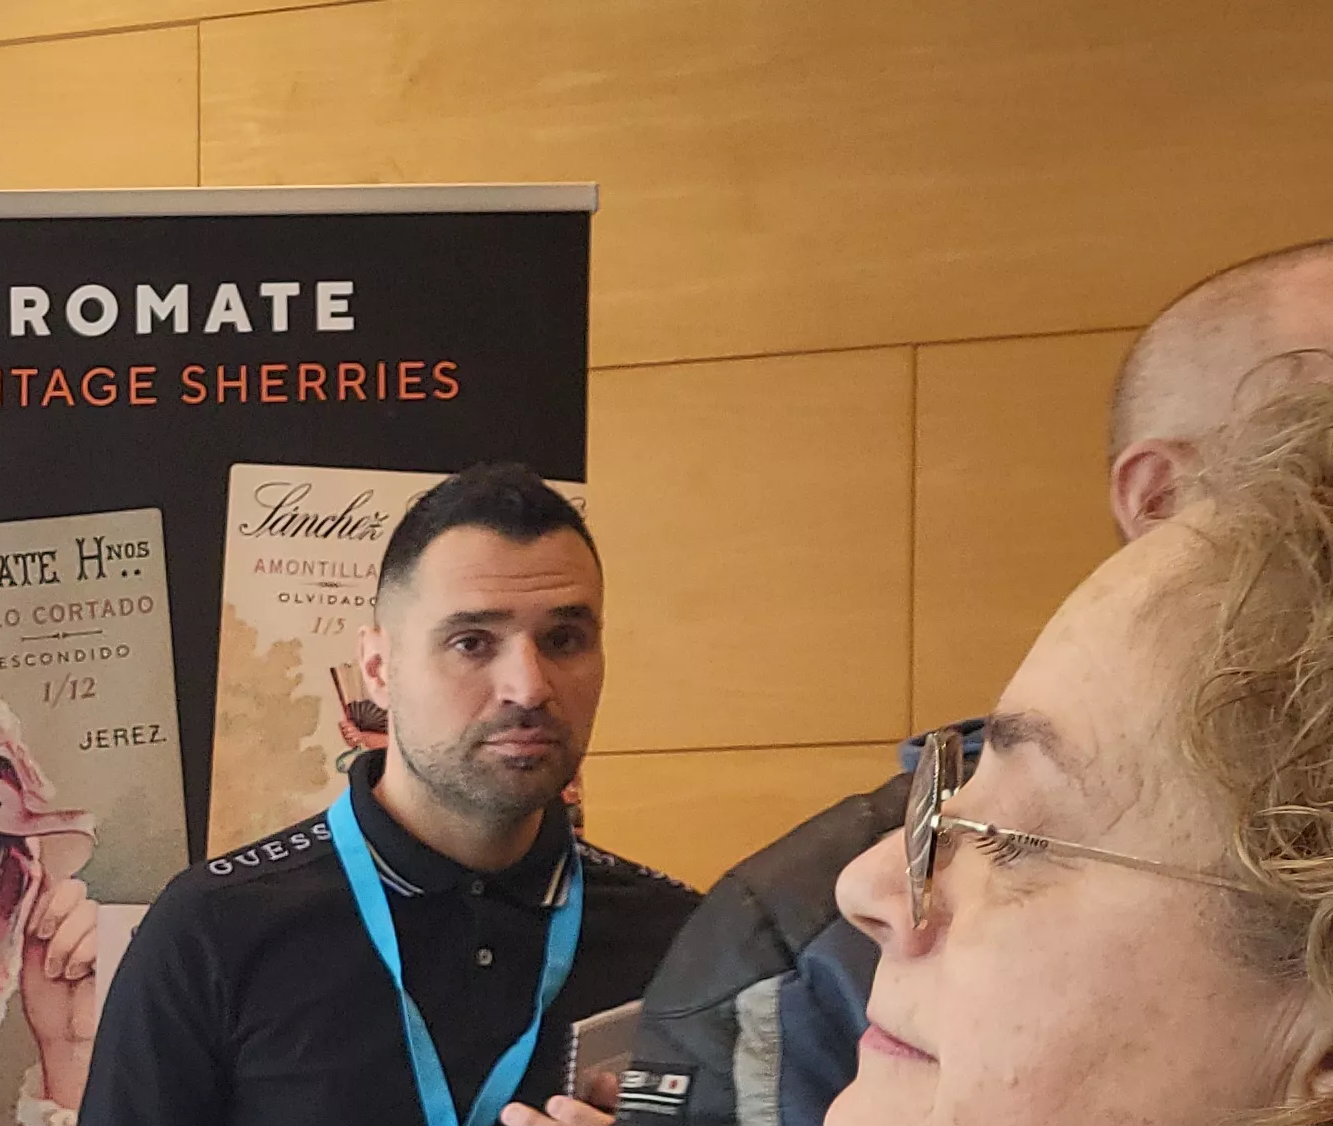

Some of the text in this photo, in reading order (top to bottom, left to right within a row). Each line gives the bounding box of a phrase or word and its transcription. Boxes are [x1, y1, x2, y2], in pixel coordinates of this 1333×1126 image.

[8, 281, 355, 337] ROMATE
[181, 360, 460, 405] SHERRIES
[254, 559, 377, 579] AMONTILLA
[32, 596, 155, 625] CORTADO
[309, 616, 348, 636] 1/5
[42, 675, 97, 708] 1/12
[208, 822, 332, 875] GUESS
